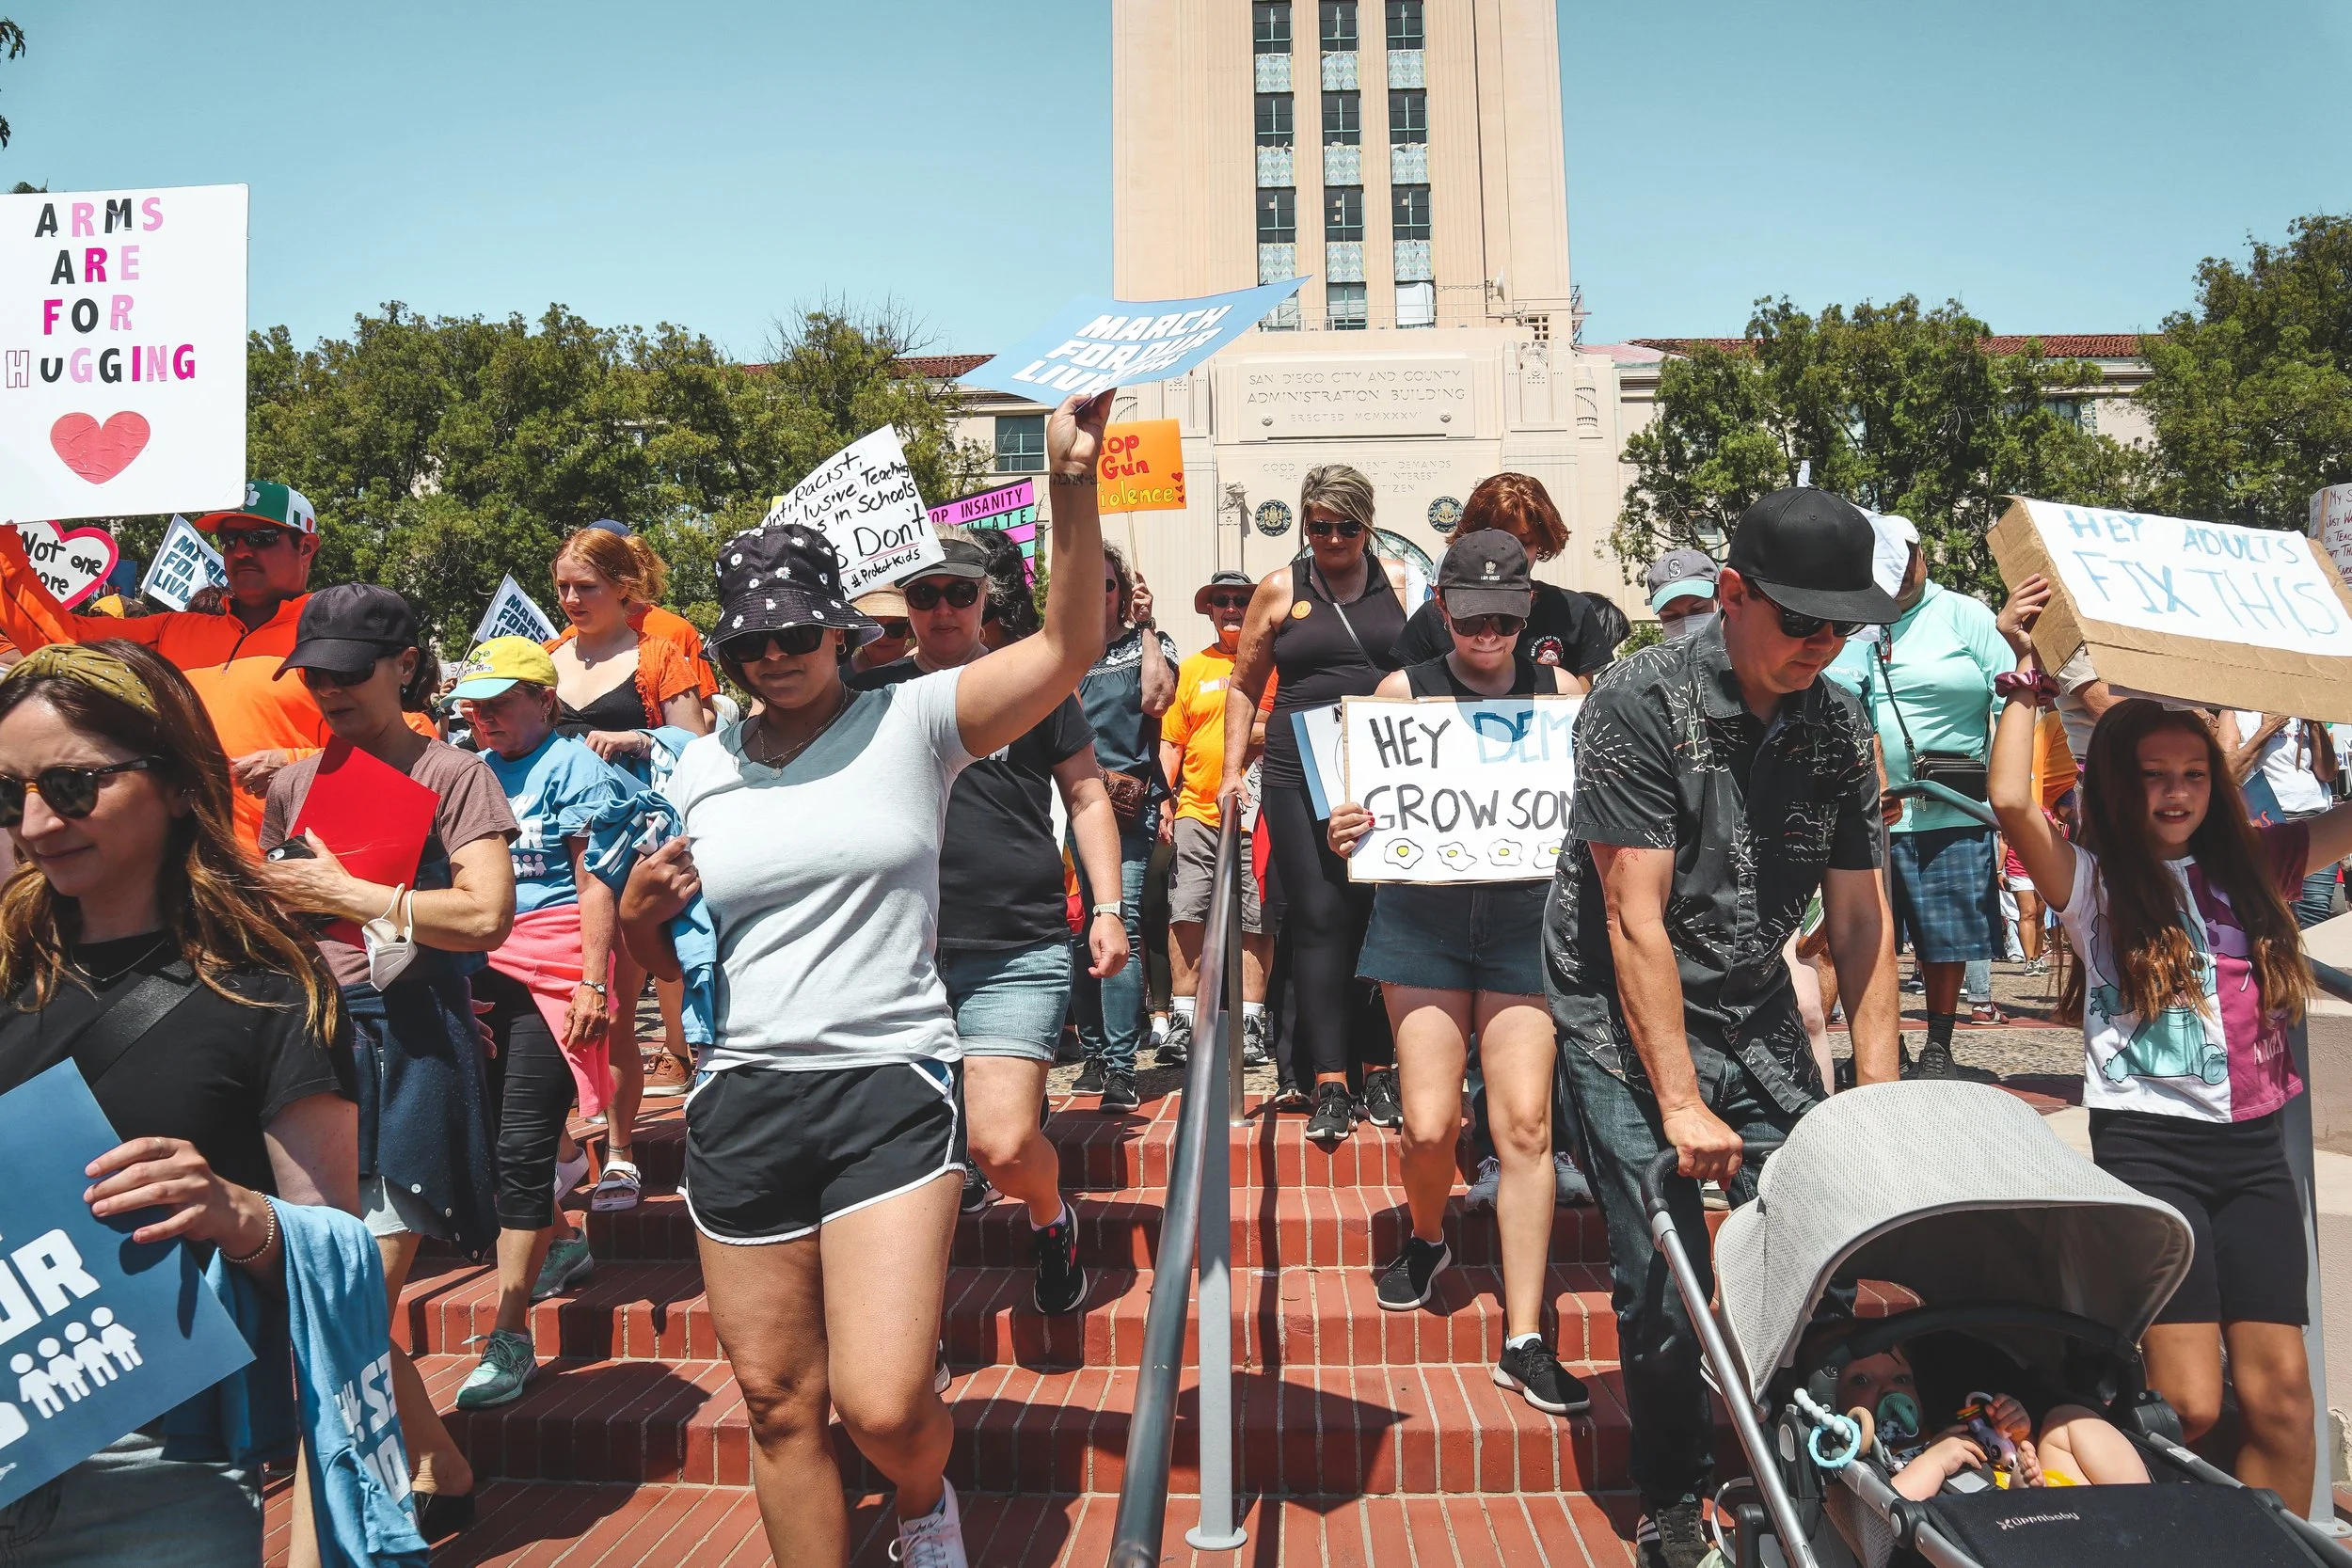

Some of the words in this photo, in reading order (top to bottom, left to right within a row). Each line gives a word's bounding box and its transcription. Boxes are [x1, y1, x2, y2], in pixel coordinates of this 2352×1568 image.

[34, 197, 164, 238] ARMS
[50, 245, 140, 285] ARE
[43, 293, 135, 336] FOR
[1075, 304, 1234, 341] MARCH
[1044, 340, 1143, 371] FOR
[1248, 373, 1274, 386] SAN
[1282, 372, 1325, 385] DIEGO
[1331, 372, 1362, 384] CITY
[1368, 372, 1396, 382] AND
[1404, 370, 1461, 382] COUNTY
[1247, 388, 1380, 404] ADMINISTRATION
[1391, 388, 1466, 401] BUILDING
[1290, 412, 1345, 422] ERECTED
[1101, 455, 1150, 480] Gun
[1262, 463, 1295, 472] GOOD
[1398, 460, 1453, 469] DEMANDS
[1279, 474, 1299, 483] THE
[1390, 471, 1438, 481] INTEREST
[856, 481, 916, 514] Schools
[960, 487, 1024, 519] INSANITY
[1373, 483, 1416, 494] ITIZEN
[852, 502, 926, 558] Don't
[2063, 509, 2144, 543] HEY
[2182, 522, 2300, 564] ADULTS
[71, 553, 103, 578] one
[36, 569, 70, 595] ore
[2072, 549, 2201, 618] FIX
[2185, 567, 2341, 638] THIS
[1369, 715, 1452, 768] HEY
[1364, 784, 1500, 832] GROW
